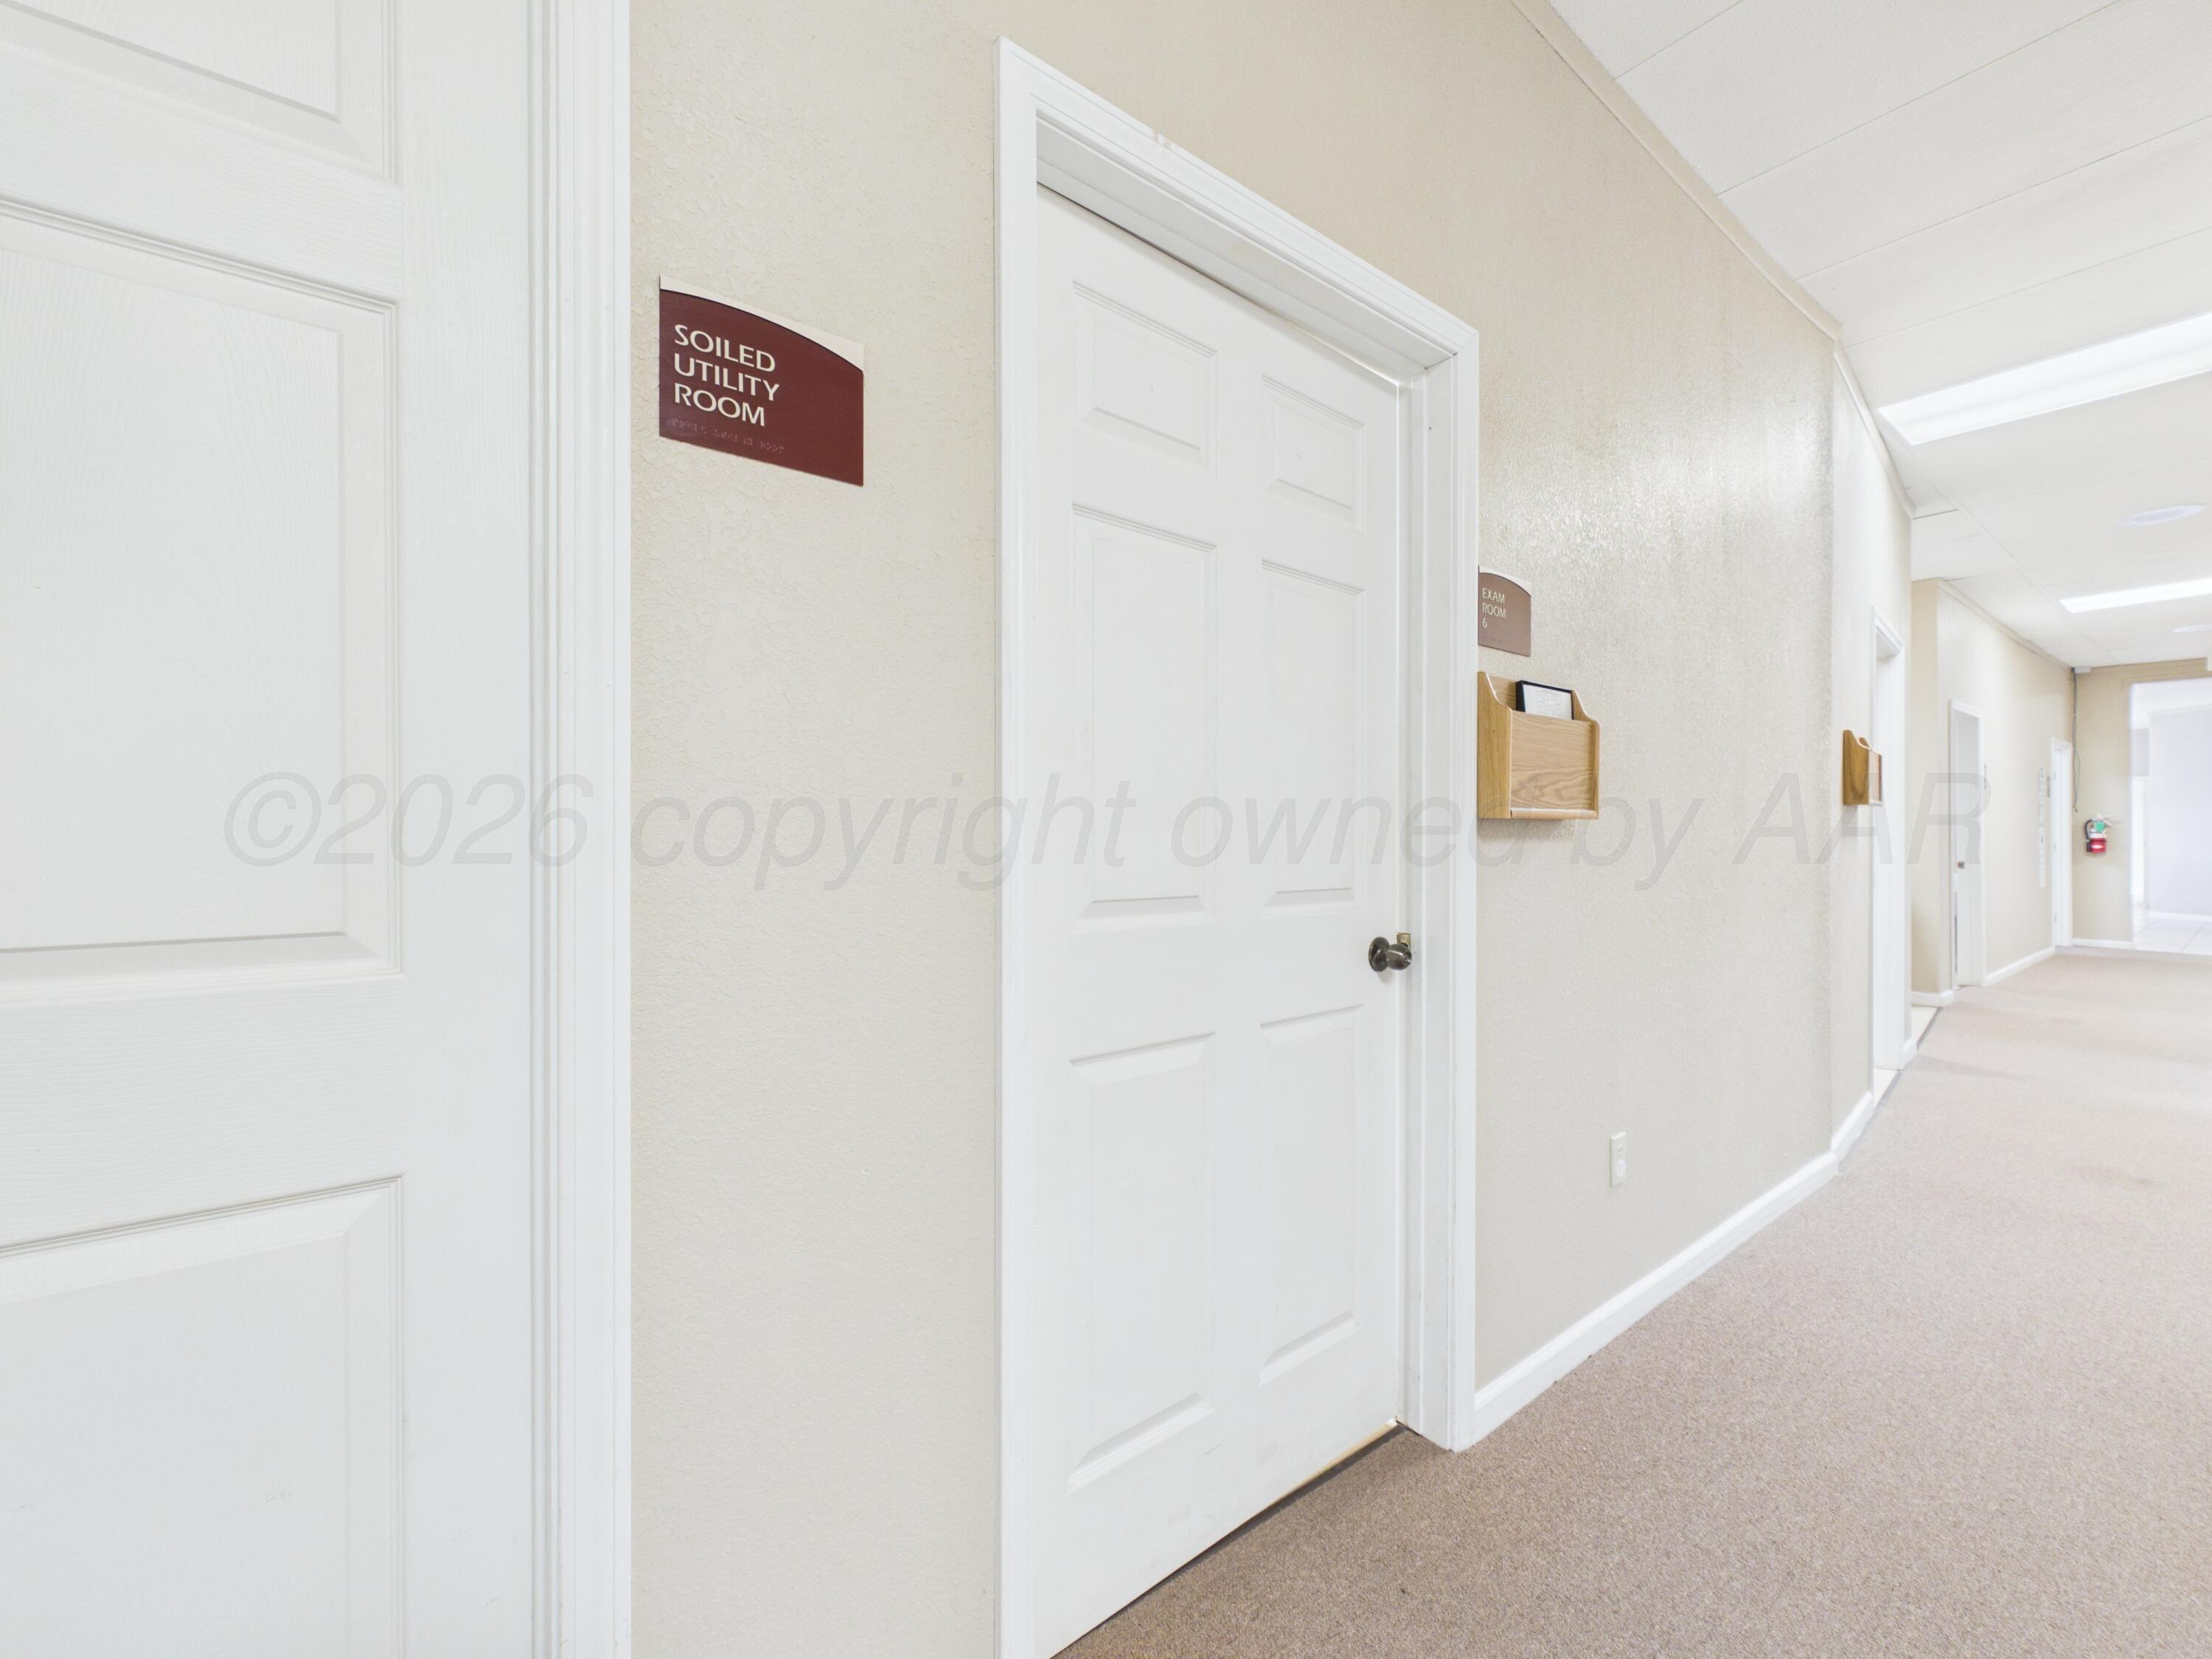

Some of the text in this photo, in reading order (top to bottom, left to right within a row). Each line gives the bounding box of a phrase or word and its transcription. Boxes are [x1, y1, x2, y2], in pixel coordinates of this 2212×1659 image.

[674, 324, 776, 372] SOILED
[674, 352, 780, 402] UTILITY
[674, 382, 765, 428] ROOM
[1481, 588, 1506, 605] EXAM
[1481, 603, 1506, 619] ROOM
[1481, 617, 1488, 629] 6
